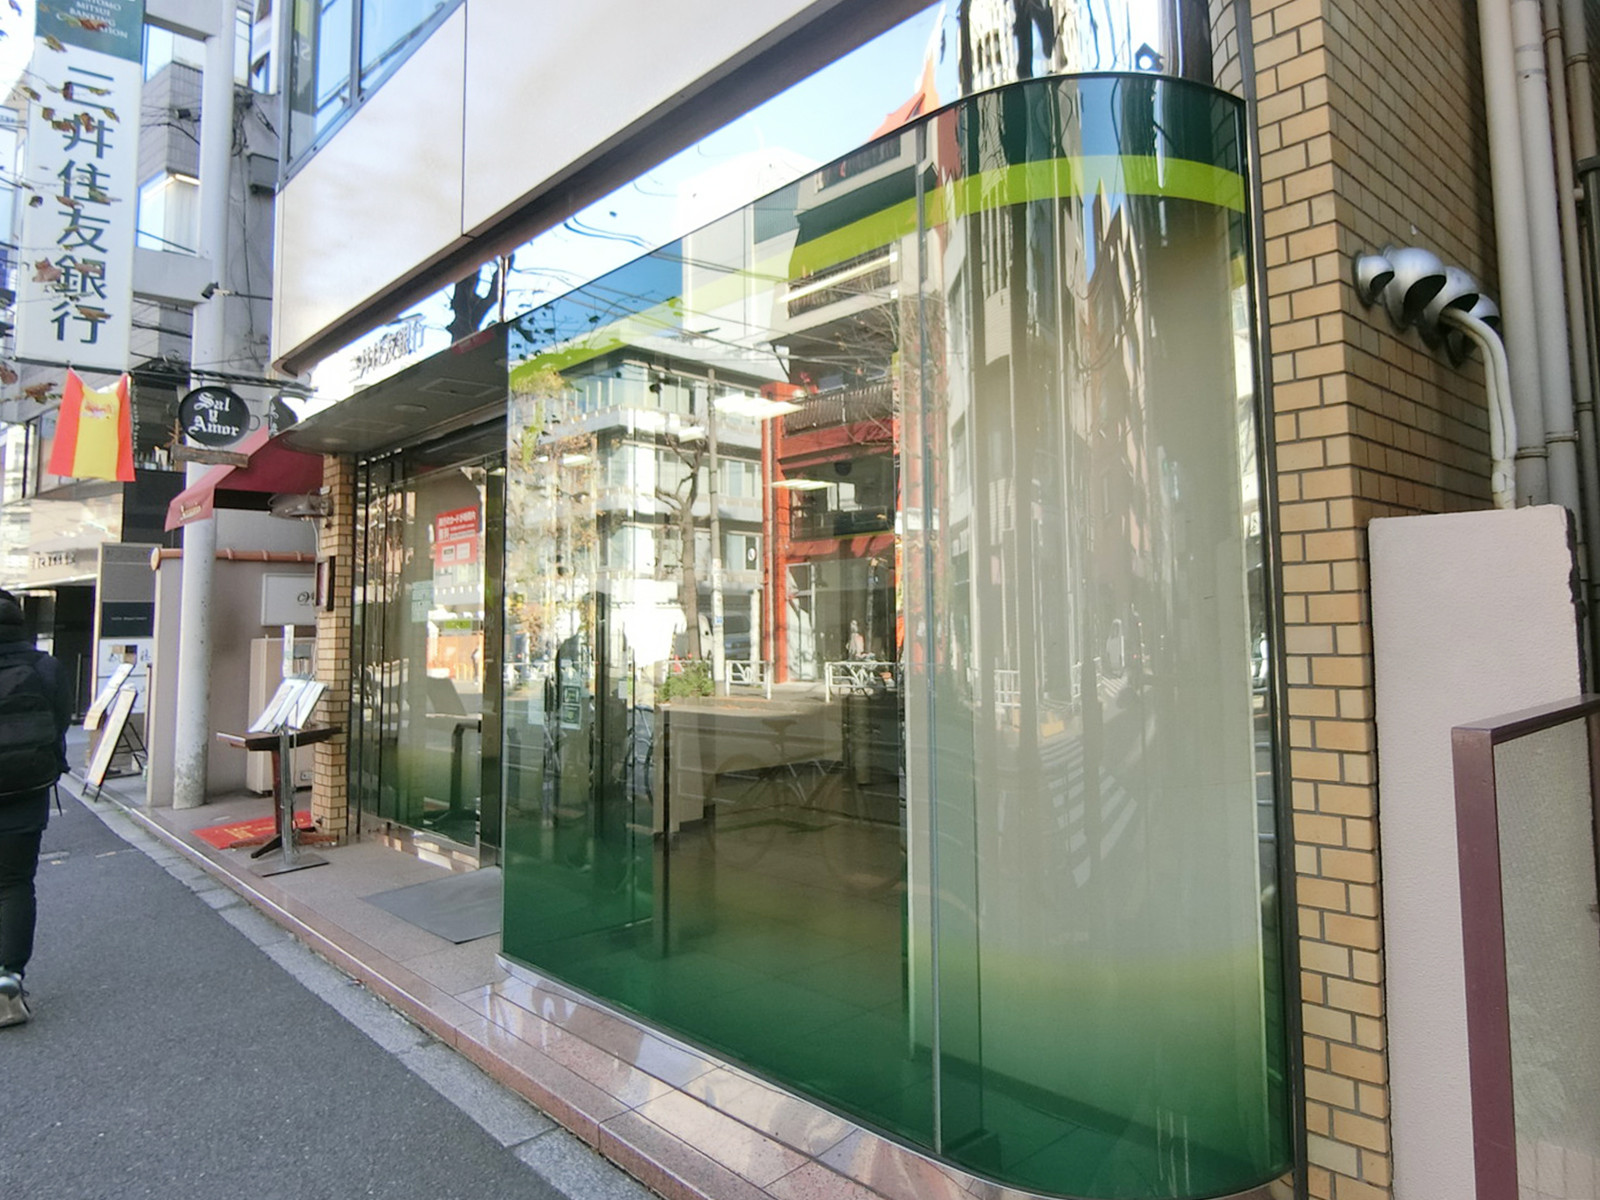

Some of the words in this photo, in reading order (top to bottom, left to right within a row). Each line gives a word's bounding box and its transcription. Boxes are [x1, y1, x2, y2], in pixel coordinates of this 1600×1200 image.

[76, 1, 110, 17] MITSUI
[50, 66, 114, 345] 三井住友銀行
[194, 392, 231, 412] Sal
[188, 415, 240, 437] Amor
[208, 409, 219, 423] y
